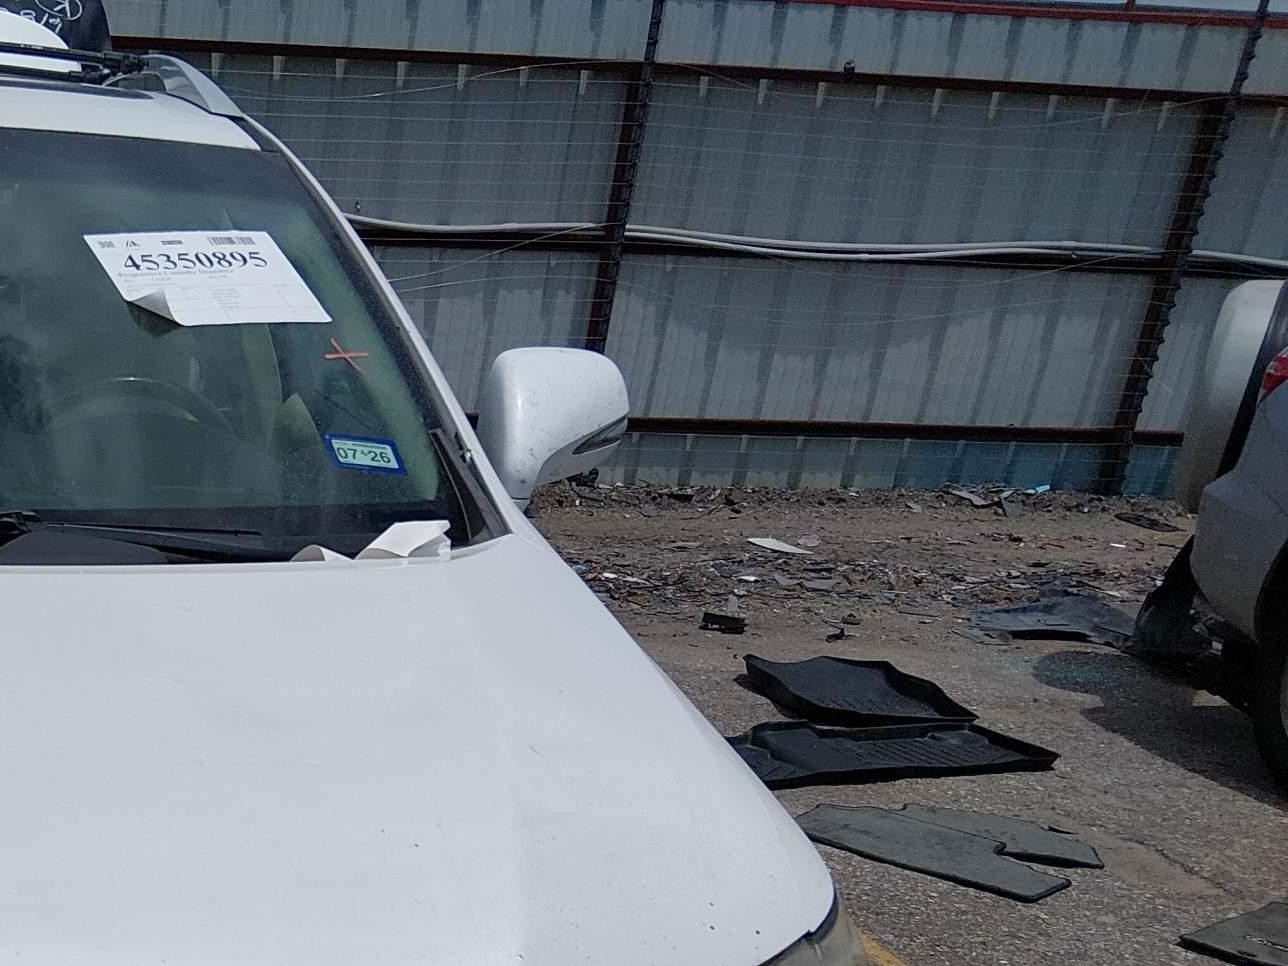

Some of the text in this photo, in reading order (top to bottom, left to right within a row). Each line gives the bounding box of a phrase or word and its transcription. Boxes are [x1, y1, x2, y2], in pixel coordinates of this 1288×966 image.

[124, 251, 267, 271] 45350895
[336, 447, 391, 463] 07 26
